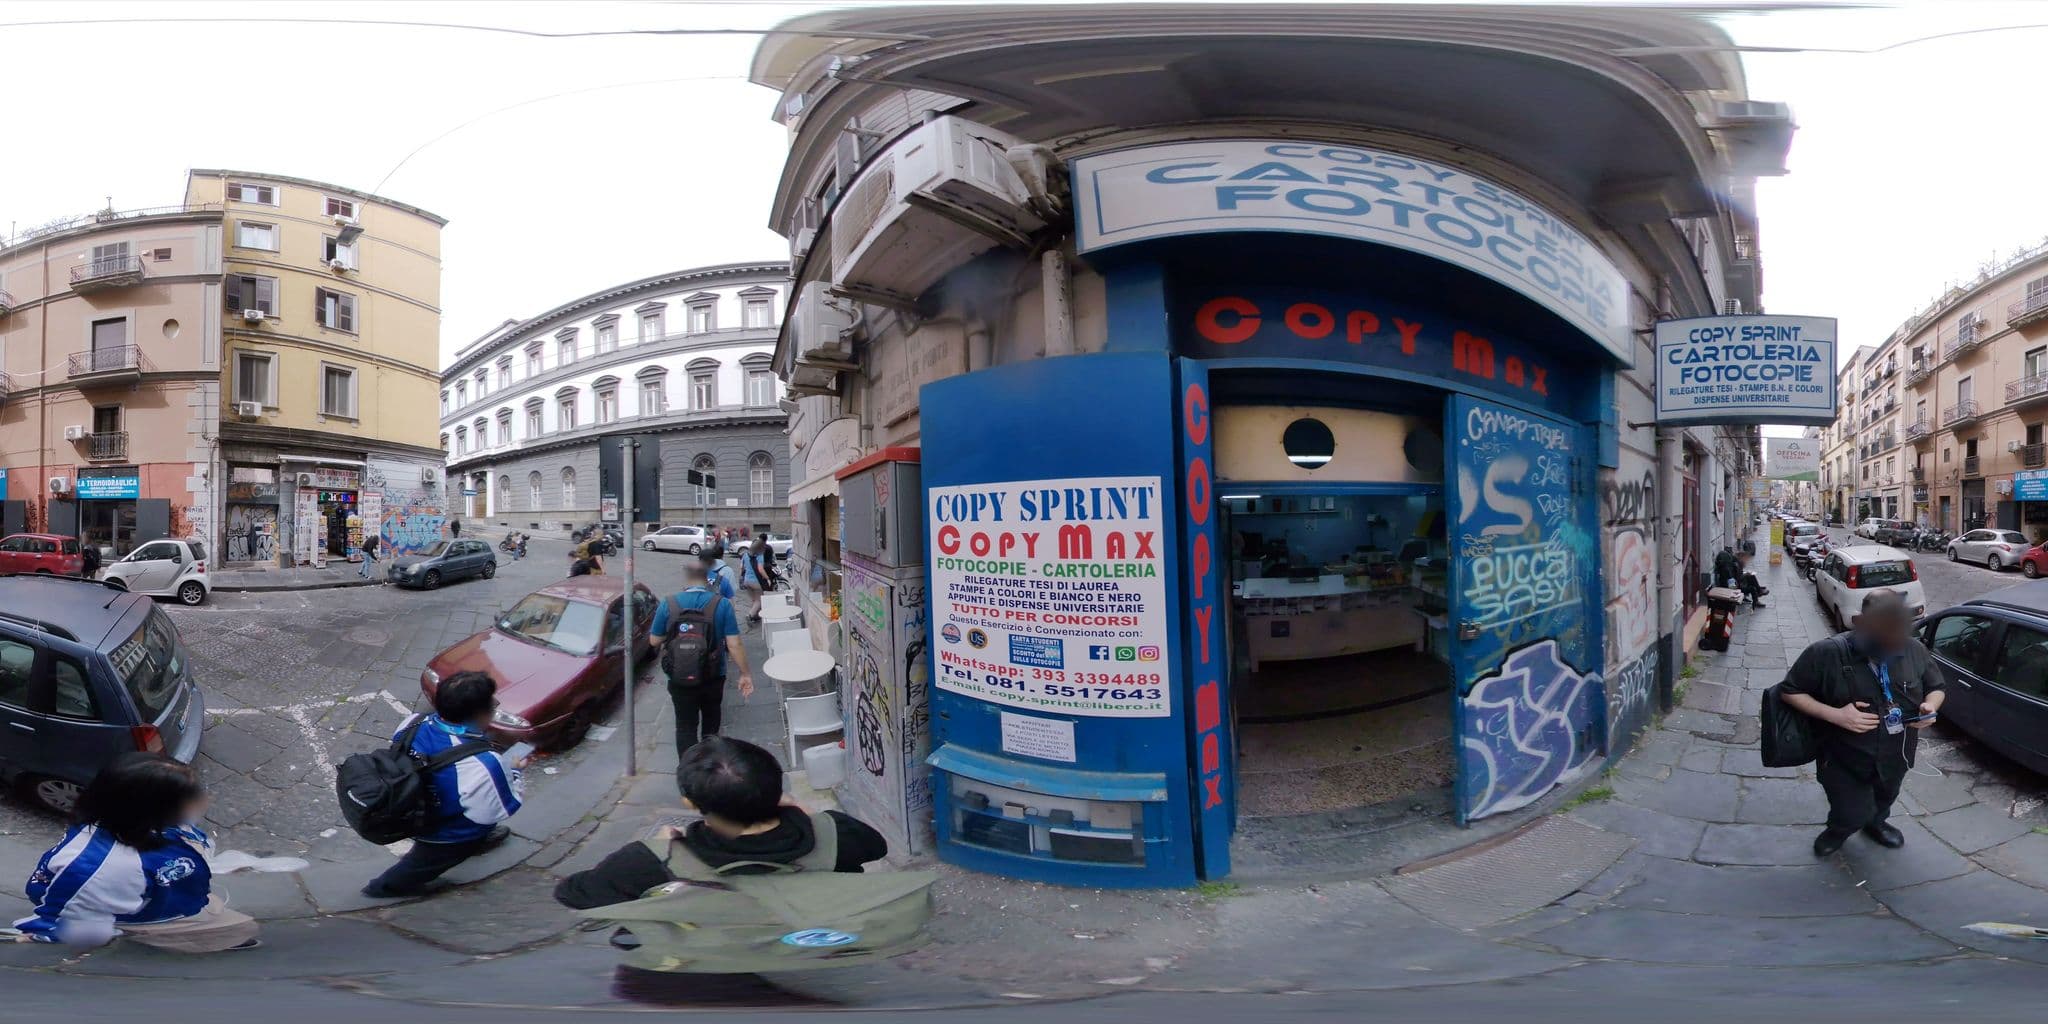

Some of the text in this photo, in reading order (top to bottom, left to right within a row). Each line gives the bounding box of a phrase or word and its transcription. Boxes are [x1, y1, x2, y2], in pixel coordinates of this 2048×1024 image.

[1264, 144, 1587, 249] COPY SPRINT
[1146, 162, 1614, 305] CARTOLERIA
[1216, 186, 1607, 328] FOTOCOPIE
[1690, 325, 1802, 344] COPY SPRINT
[1668, 344, 1822, 364] CARTOLERIA
[1681, 364, 1813, 384] FOTOCOPIE
[1669, 386, 1714, 396] RILEGATURE
[1717, 384, 1732, 393] TESI
[1739, 384, 1769, 393] STAMPE
[1788, 384, 1793, 392] E
[1795, 384, 1823, 393] COLORI
[1694, 395, 1790, 405] DISPENSE UNIVERSITARIE
[936, 486, 1154, 522] COPY SPRINT
[938, 524, 1040, 559] COPY
[937, 557, 1026, 576] FOTOCOPIE
[1043, 563, 1156, 578] CARTOLERIA
[949, 583, 1141, 602] STAMPE A COLORI E BIANCO E NERO
[964, 575, 1119, 591] RILEGATURE TESI DI LAUREA
[948, 593, 1144, 613] APPUNTI E DISPENSE UNIVERSITARIE
[951, 603, 1138, 626] TUTTO PER CONCORSI
[949, 613, 978, 626] Questo
[981, 619, 1023, 632] Esercizio
[1035, 625, 1115, 638] Convenzionato
[1119, 630, 1143, 638] con:
[941, 650, 1161, 685] Whatsapp: 393 3394489
[941, 664, 1162, 700] Tel. 081. 5517643
[941, 676, 985, 693] E-mail:
